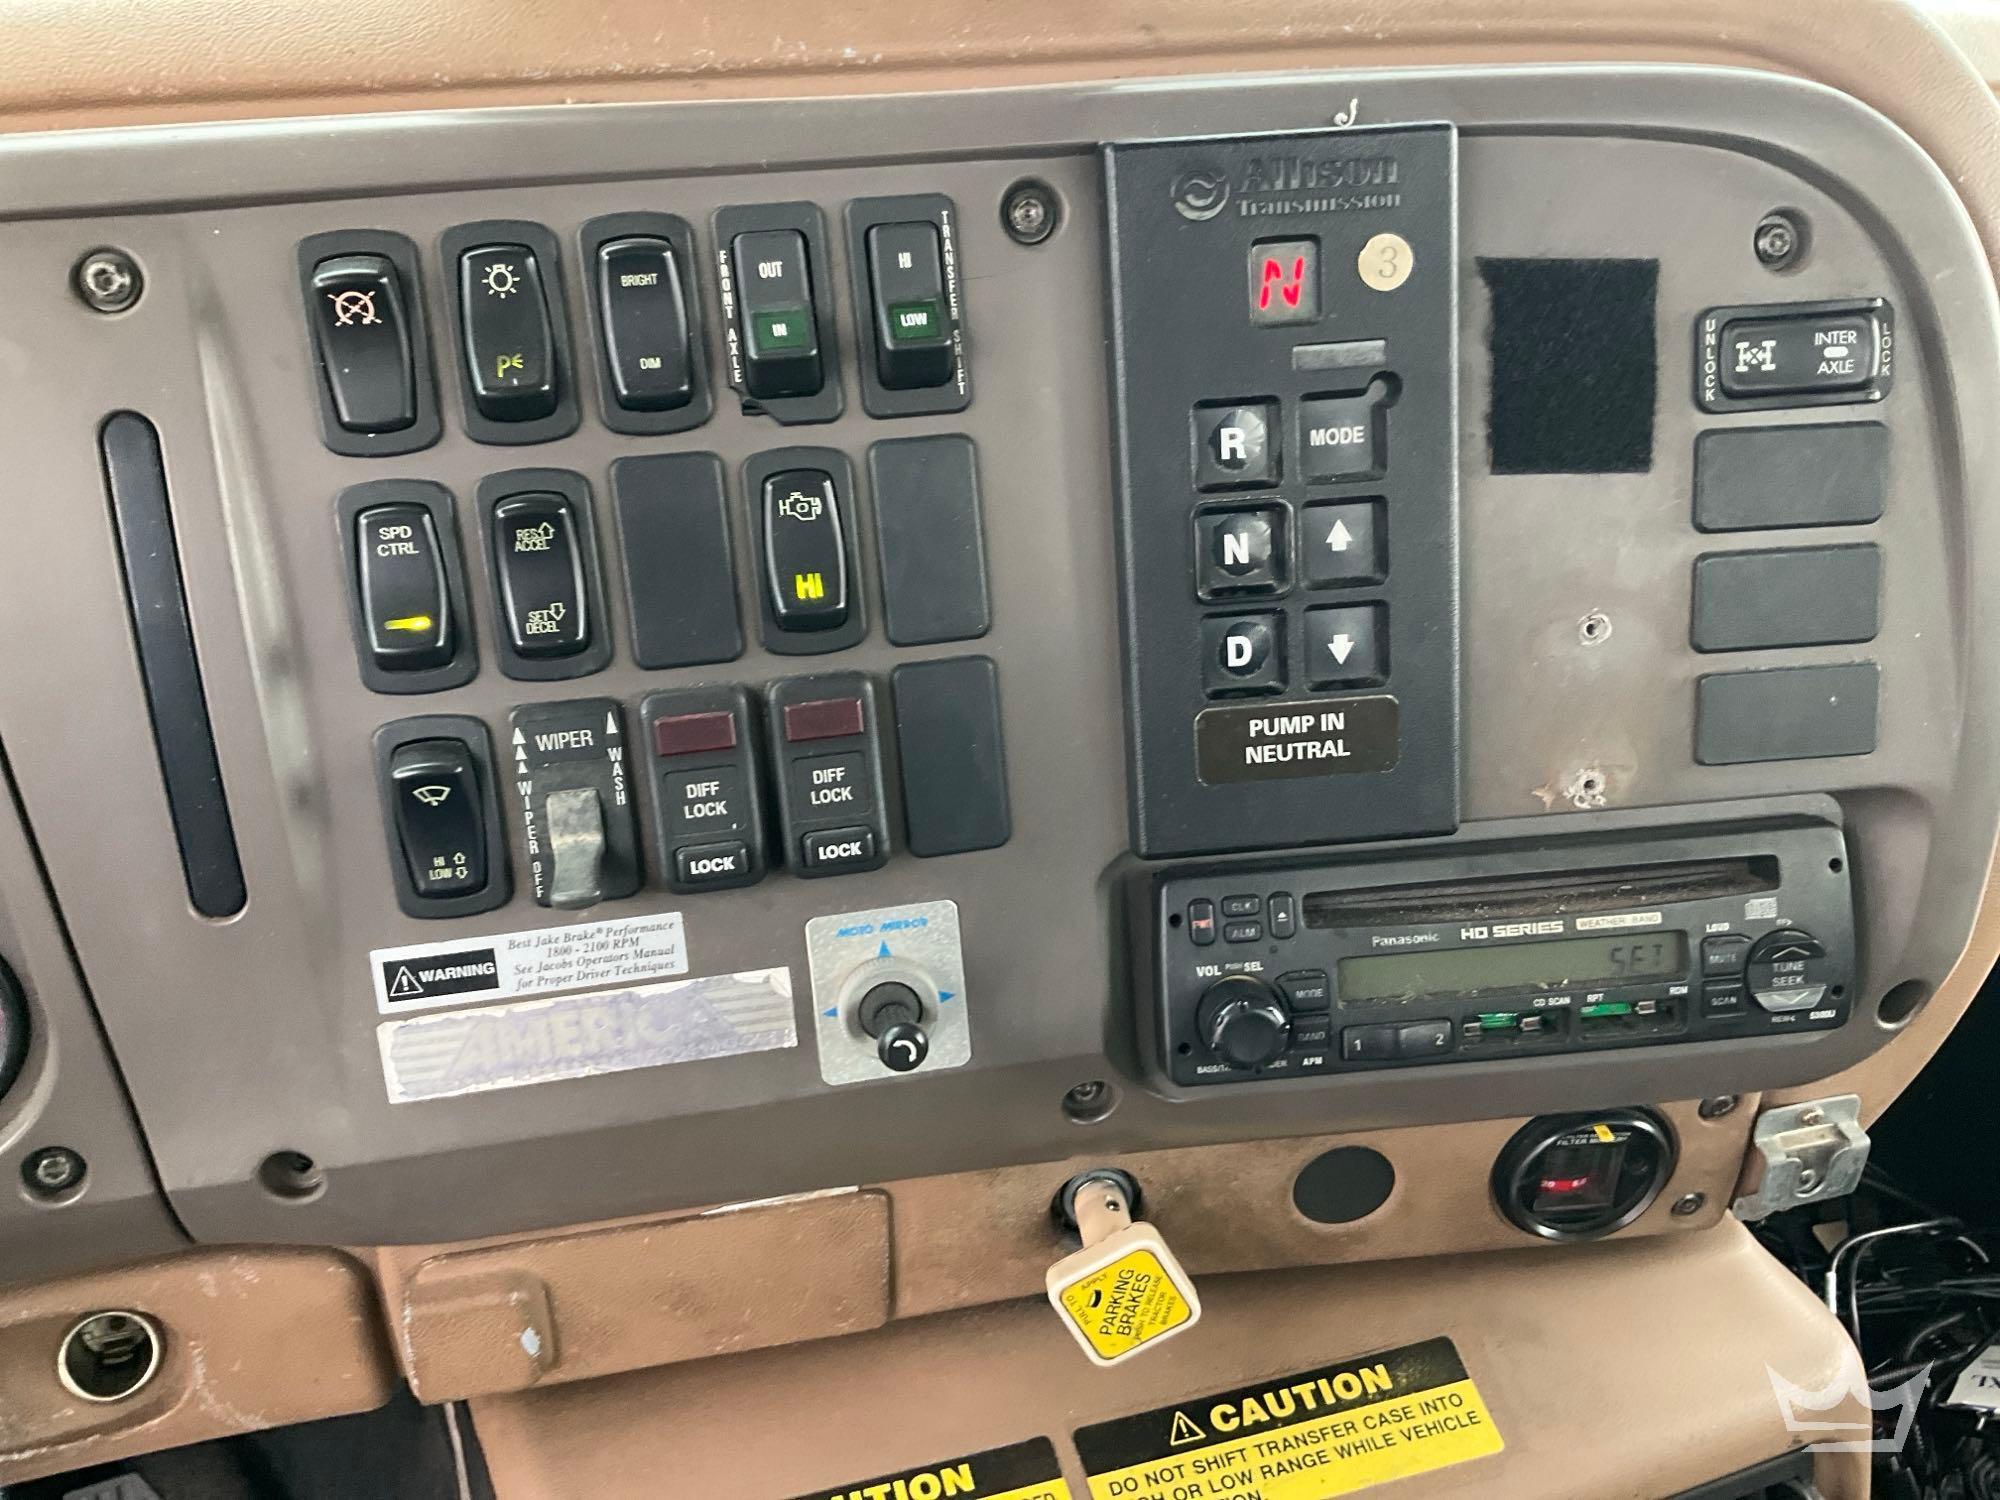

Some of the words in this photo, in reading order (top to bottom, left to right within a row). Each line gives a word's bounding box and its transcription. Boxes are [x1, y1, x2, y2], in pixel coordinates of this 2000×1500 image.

[1239, 159, 1399, 192] Allison
[1240, 194, 1400, 216] Transmission
[758, 261, 783, 279] OUT
[898, 252, 912, 269] HI
[1379, 246, 1397, 278] 3
[621, 272, 658, 287] BRIGHT
[1260, 256, 1304, 309] N
[941, 210, 958, 320] TRANSFER
[953, 330, 965, 395] SHIFT
[719, 250, 733, 319] FRONT
[728, 328, 742, 383] AXLE
[900, 312, 928, 327] LOW
[772, 323, 787, 337] IN
[1814, 330, 1858, 345] INTER
[1705, 319, 1716, 401] UNLOCK
[1881, 323, 1892, 377] LOCK
[640, 357, 661, 369] DIM
[1817, 359, 1855, 374] AXLE
[1220, 427, 1247, 460] R
[1310, 426, 1365, 446] MODE
[379, 525, 412, 541] SPD
[377, 541, 419, 558] CTRL
[1223, 532, 1249, 564] N
[795, 572, 824, 600] HI
[528, 609, 551, 622] SET
[526, 620, 560, 634] DECEL
[1227, 636, 1252, 667] D
[1249, 715, 1315, 737] PUMP
[1320, 712, 1345, 732] IN
[535, 729, 594, 752] WIPER
[1245, 738, 1351, 764] NEUTRAL
[607, 747, 627, 806] WASH
[813, 767, 846, 786] DIFF
[686, 781, 721, 798] DIFF
[810, 786, 854, 805] LOCK
[517, 780, 540, 855] WIPER
[684, 801, 728, 819] LOCK
[819, 840, 862, 861] LOCK
[433, 856, 445, 867] HI
[690, 855, 735, 875] LOCK
[429, 867, 452, 880] LOW
[1461, 926, 1489, 940] HD
[1493, 921, 1564, 937] SERIES
[1579, 917, 1625, 928] WEATHER
[508, 938, 532, 950] Best
[535, 935, 560, 947] Jake
[605, 922, 674, 937] Performance
[1372, 931, 1440, 946] Panasonic
[547, 944, 572, 958] 1800
[584, 942, 609, 953] 2100
[613, 937, 639, 949] RPM
[514, 964, 532, 975] See
[536, 959, 573, 973] Jacobs
[576, 954, 629, 967] Operators
[633, 944, 675, 959] Manual
[1196, 965, 1222, 977] VOL
[1243, 961, 1263, 971] SEL
[1772, 961, 1805, 972] TUNE
[418, 962, 495, 983] WARNING
[516, 979, 533, 991] for
[537, 972, 573, 986] Proper
[577, 968, 610, 981] Driver
[615, 960, 675, 976] Techniques
[1771, 975, 1805, 987] SEEK
[1295, 988, 1324, 998] MODE
[1548, 996, 1571, 1005] SCAN
[1587, 993, 1604, 1002] RPT
[1354, 1039, 1361, 1050] 1
[1435, 1033, 1444, 1045] 2
[1100, 1269, 1134, 1336] PARKING
[1117, 1273, 1151, 1336] BRAKES
[1210, 1363, 1393, 1432] CAUTION
[1109, 1477, 1138, 1496] DO
[1144, 1464, 1185, 1487] NOT
[1192, 1448, 1247, 1474] SHIFT
[1253, 1421, 1359, 1458] TRANSFER
[1363, 1405, 1416, 1430] CASE
[1419, 1393, 1463, 1416] INTO
[1173, 1483, 1203, 1500] OR
[1207, 1469, 1253, 1494] LOW
[1260, 1450, 1331, 1479] RANGE
[1334, 1432, 1397, 1460] WHILE
[1399, 1410, 1481, 1442] VEHICLE
